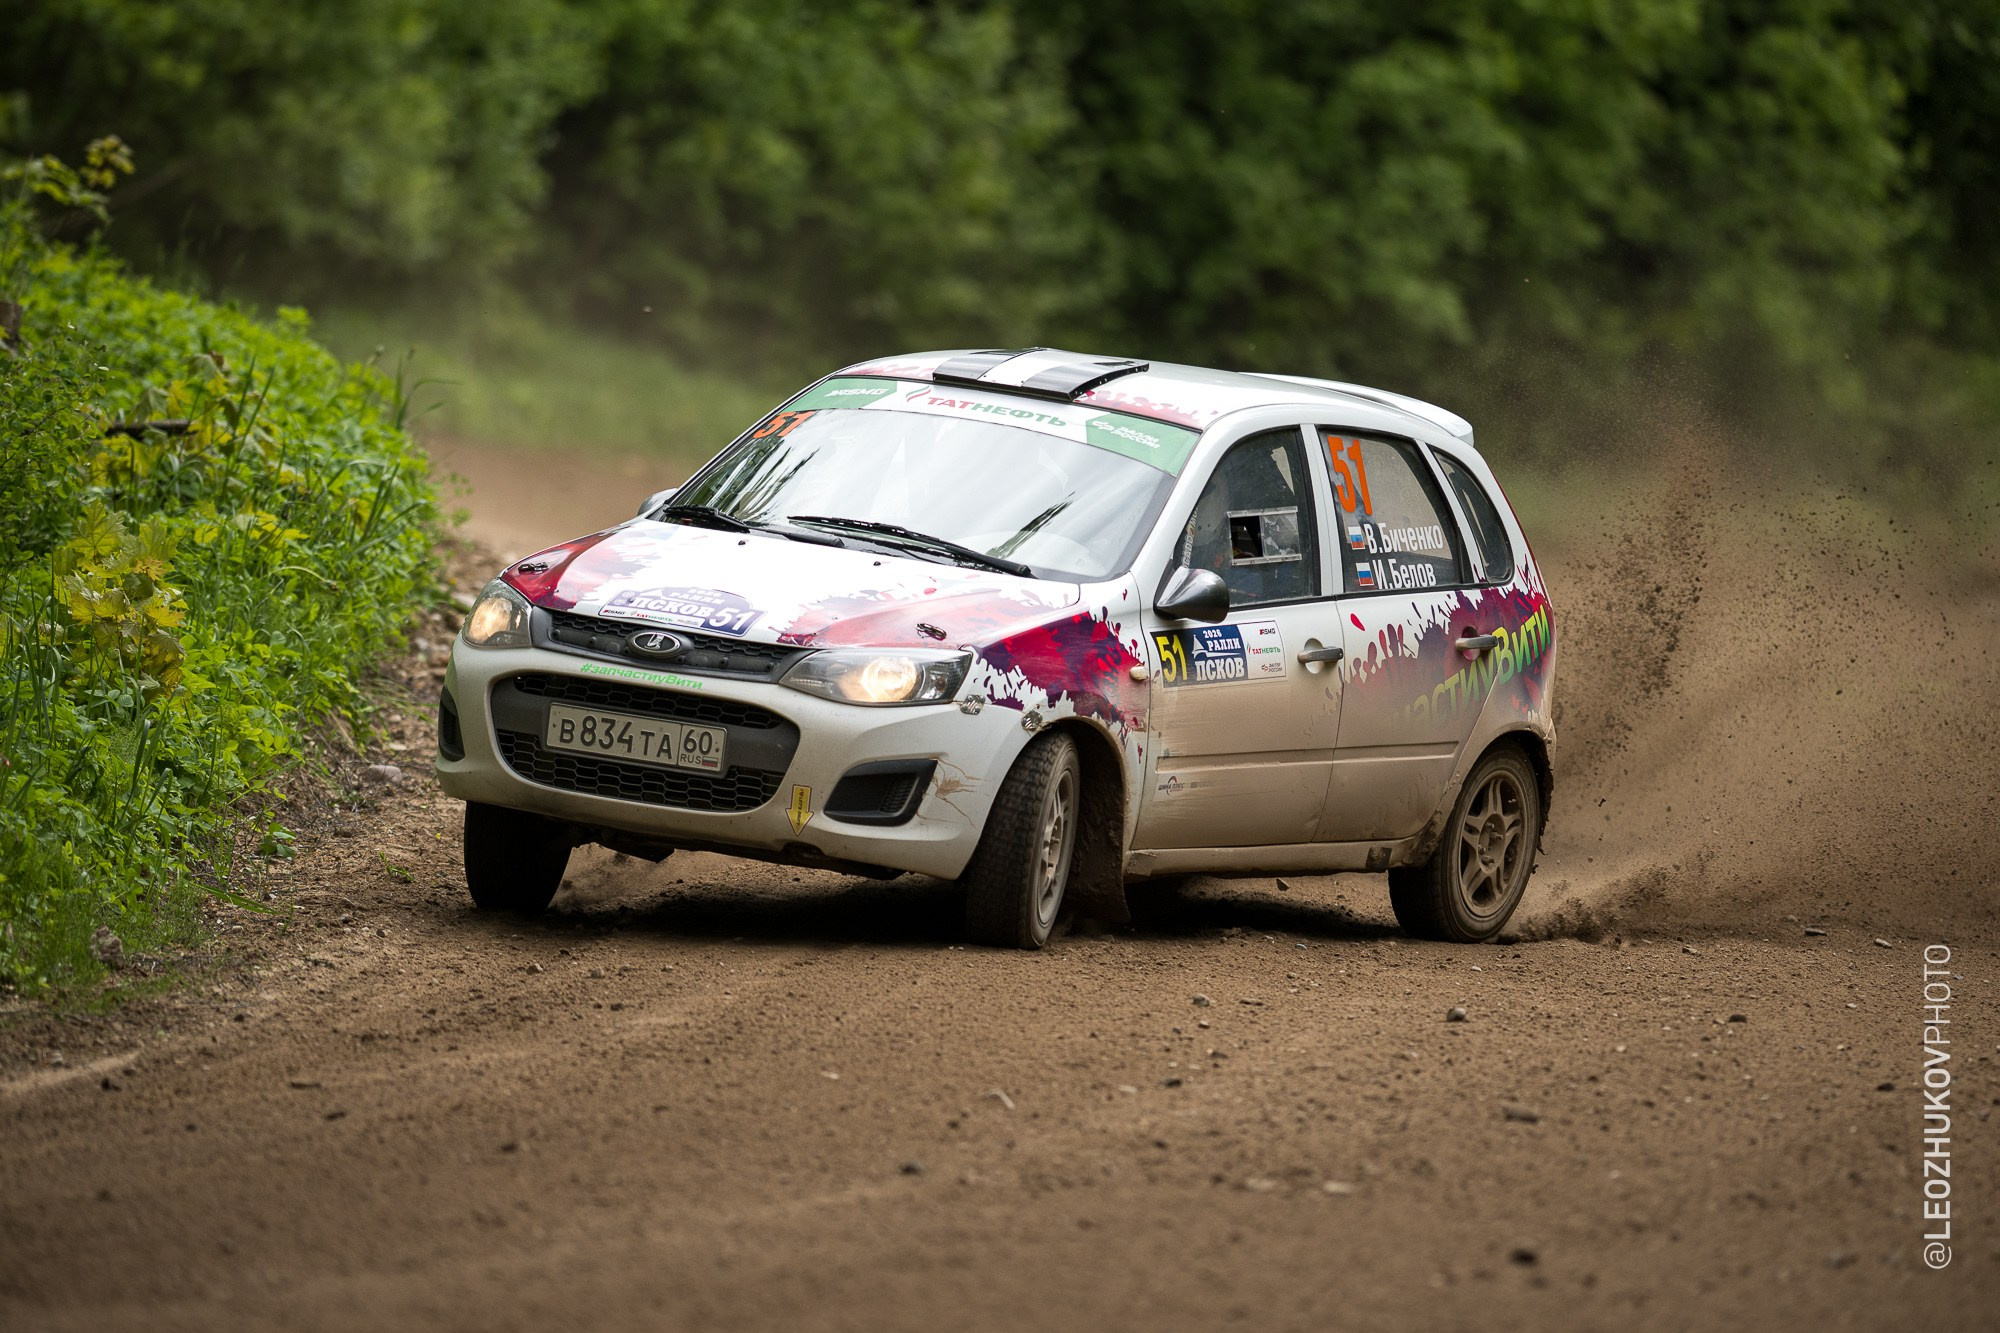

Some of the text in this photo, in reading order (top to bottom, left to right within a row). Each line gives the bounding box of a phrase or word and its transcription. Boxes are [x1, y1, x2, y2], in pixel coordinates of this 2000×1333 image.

[752, 410, 817, 439] 51
[927, 396, 1067, 428] ТАТНЕФТЬ
[1327, 434, 1373, 515] 51
[1364, 522, 1444, 554] В.Биченко
[1373, 558, 1437, 589] И.Белов
[669, 591, 727, 605] РАЛЛИ
[629, 596, 756, 631] ПСКОВ 51
[1202, 628, 1223, 639] 2026
[1207, 637, 1241, 651] РАЛЛИ
[1156, 634, 1188, 683] 51
[1251, 646, 1281, 655] ТАТНЕФТЬ
[580, 663, 703, 689] #запчастиуВити
[1194, 657, 1245, 681] ПСКОВ
[683, 729, 713, 755] 60
[680, 753, 701, 765] RUS
